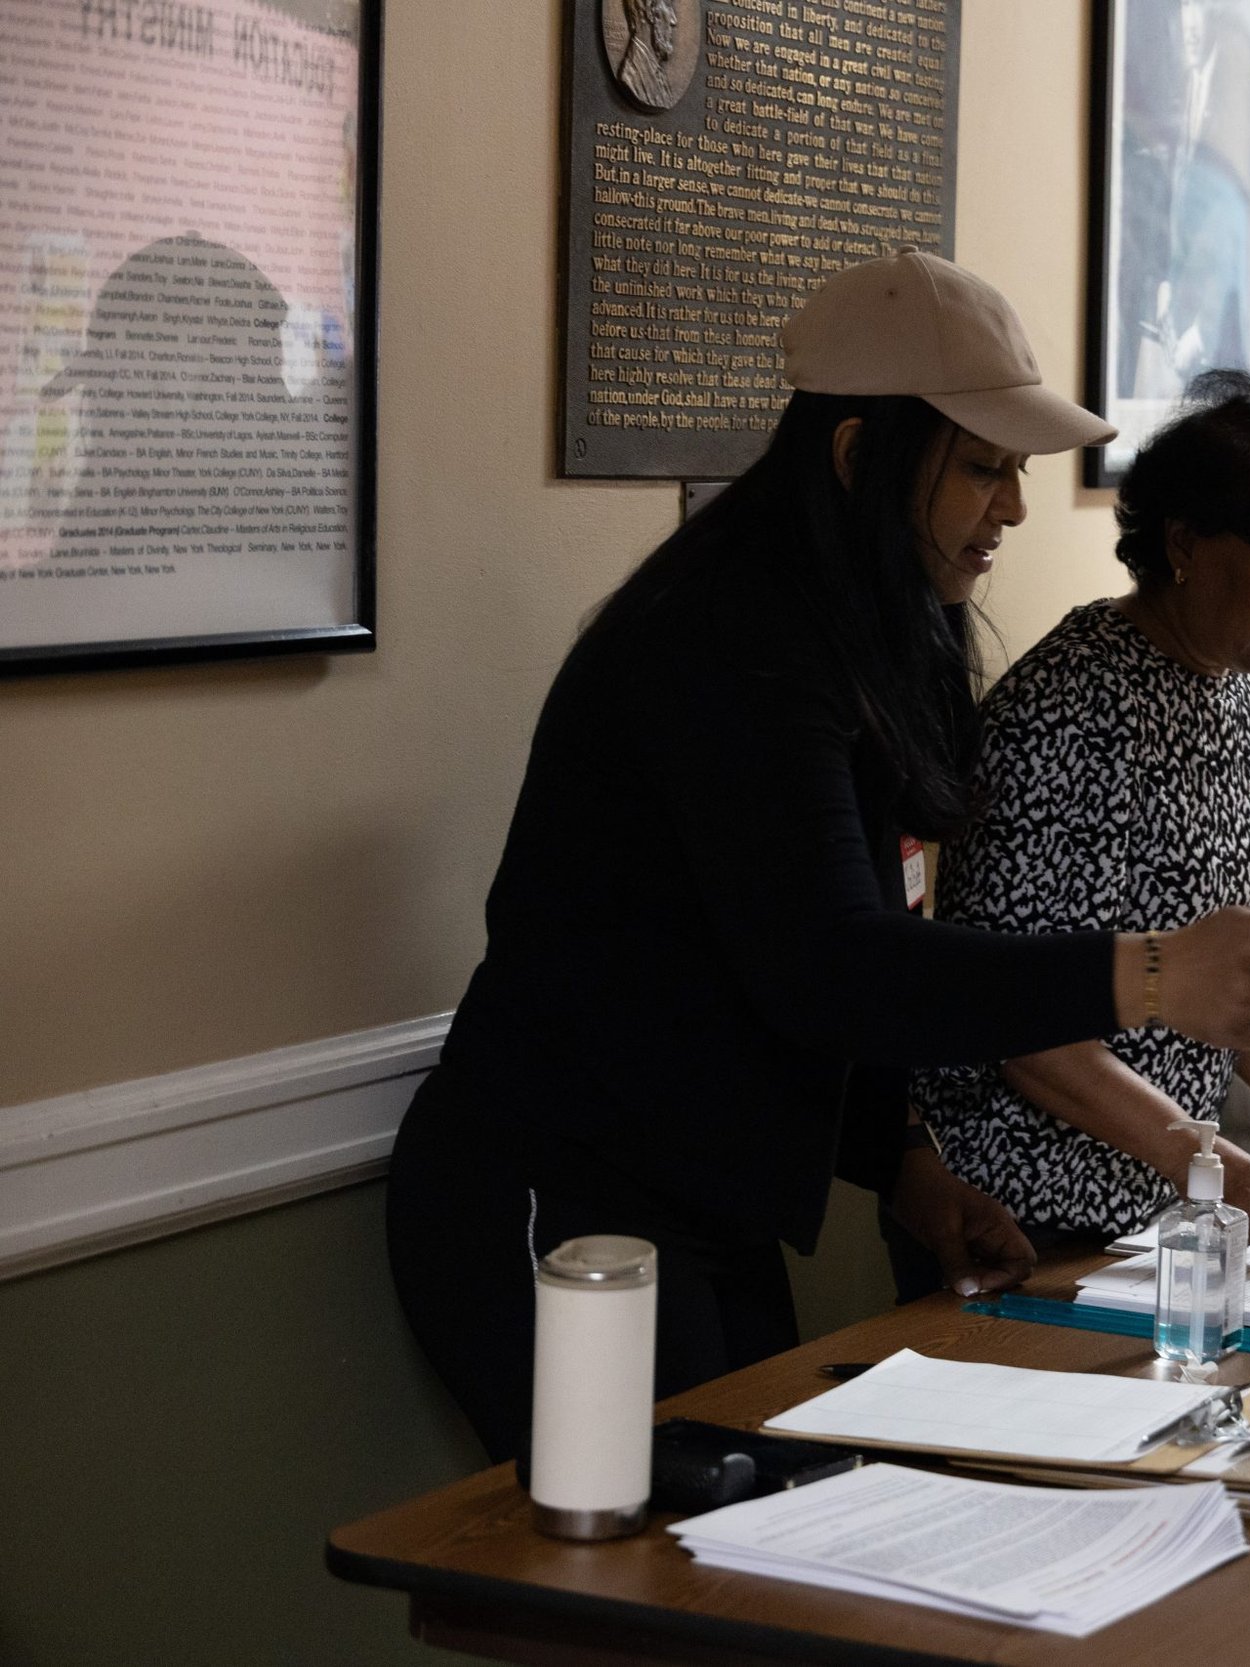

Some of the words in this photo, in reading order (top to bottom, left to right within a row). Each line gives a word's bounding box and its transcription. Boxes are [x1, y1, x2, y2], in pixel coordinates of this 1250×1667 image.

[707, 11, 772, 34] proposition
[779, 20, 803, 41] that
[808, 26, 822, 46] all
[828, 35, 849, 51] men
[855, 40, 871, 56] are
[876, 45, 912, 64] created
[844, 16, 862, 35] and
[866, 18, 912, 45] dedicated
[707, 26, 730, 48] Now
[753, 40, 770, 56] are
[774, 45, 815, 67] engaged
[841, 58, 867, 76] great
[870, 60, 890, 80] civil
[707, 49, 751, 73] whether
[756, 58, 777, 78] that
[782, 65, 817, 89] nation,
[833, 77, 850, 97] any
[855, 78, 886, 98] nation
[707, 71, 727, 90] and
[745, 75, 795, 104] dedicated,
[796, 90, 814, 105] can
[817, 88, 837, 114] long
[895, 107, 910, 122] are
[717, 97, 746, 115] great
[752, 98, 808, 125] battle-field
[830, 112, 850, 132] that
[897, 123, 918, 143] have
[723, 114, 767, 139] dedicate
[787, 128, 824, 148] portion
[846, 135, 866, 155] that
[872, 139, 893, 160] field
[596, 120, 672, 147] resting-place
[677, 129, 692, 149] for
[698, 134, 727, 155] those
[732, 139, 754, 158] who
[759, 141, 782, 162] here
[786, 151, 809, 168] gave
[814, 151, 837, 171] their
[842, 154, 863, 174] lives
[867, 158, 888, 178] that
[595, 140, 629, 165] might
[633, 144, 655, 165] live.
[687, 153, 741, 178] altogether
[747, 160, 779, 187] fitting
[783, 167, 801, 185] and
[805, 174, 836, 195] proper
[838, 174, 857, 194] that
[876, 180, 907, 201] should
[642, 167, 675, 192] larger
[727, 183, 761, 200] cannot
[820, 196, 850, 212] cannot
[594, 211, 661, 231] consecrated
[675, 216, 691, 235] far
[692, 219, 720, 238] above
[725, 226, 742, 241] our
[744, 229, 768, 246] poor
[770, 232, 798, 249] power
[813, 231, 830, 250] add
[697, 197, 715, 217] The
[717, 199, 745, 220] brave
[798, 210, 816, 228] and
[593, 252, 621, 272] what
[625, 254, 650, 279] they
[653, 256, 670, 276] did
[724, 263, 740, 282] for
[758, 267, 773, 286] the
[594, 228, 622, 249] little
[625, 235, 652, 252] note
[655, 240, 674, 254] nor
[677, 237, 701, 262] long
[705, 243, 756, 263] remember
[759, 246, 784, 266] what
[803, 255, 819, 274] say
[593, 274, 610, 293] the
[615, 276, 671, 298] unfinished
[675, 282, 703, 300] work
[706, 283, 736, 302] which
[742, 285, 763, 309] they
[766, 288, 786, 307] who
[592, 317, 627, 338] before
[674, 323, 699, 342] from
[703, 326, 731, 345] these
[735, 328, 776, 349] honored
[669, 304, 701, 323] rather
[703, 305, 718, 324] for
[760, 308, 779, 327] here
[591, 340, 615, 359] that
[618, 347, 651, 361] cause
[654, 343, 669, 362] for
[672, 345, 703, 364] which
[706, 347, 729, 371] they
[731, 354, 753, 371] gave
[756, 350, 772, 369] the
[591, 362, 614, 381] here
[619, 363, 652, 388] highly
[656, 367, 692, 386] resolve
[697, 368, 718, 387] that
[722, 369, 750, 388] these
[753, 370, 776, 390] dead
[714, 389, 736, 408] have
[748, 395, 769, 409] new
[323, 413, 348, 424] College
[603, 407, 620, 425] the
[676, 410, 693, 428] the
[732, 412, 747, 430] for
